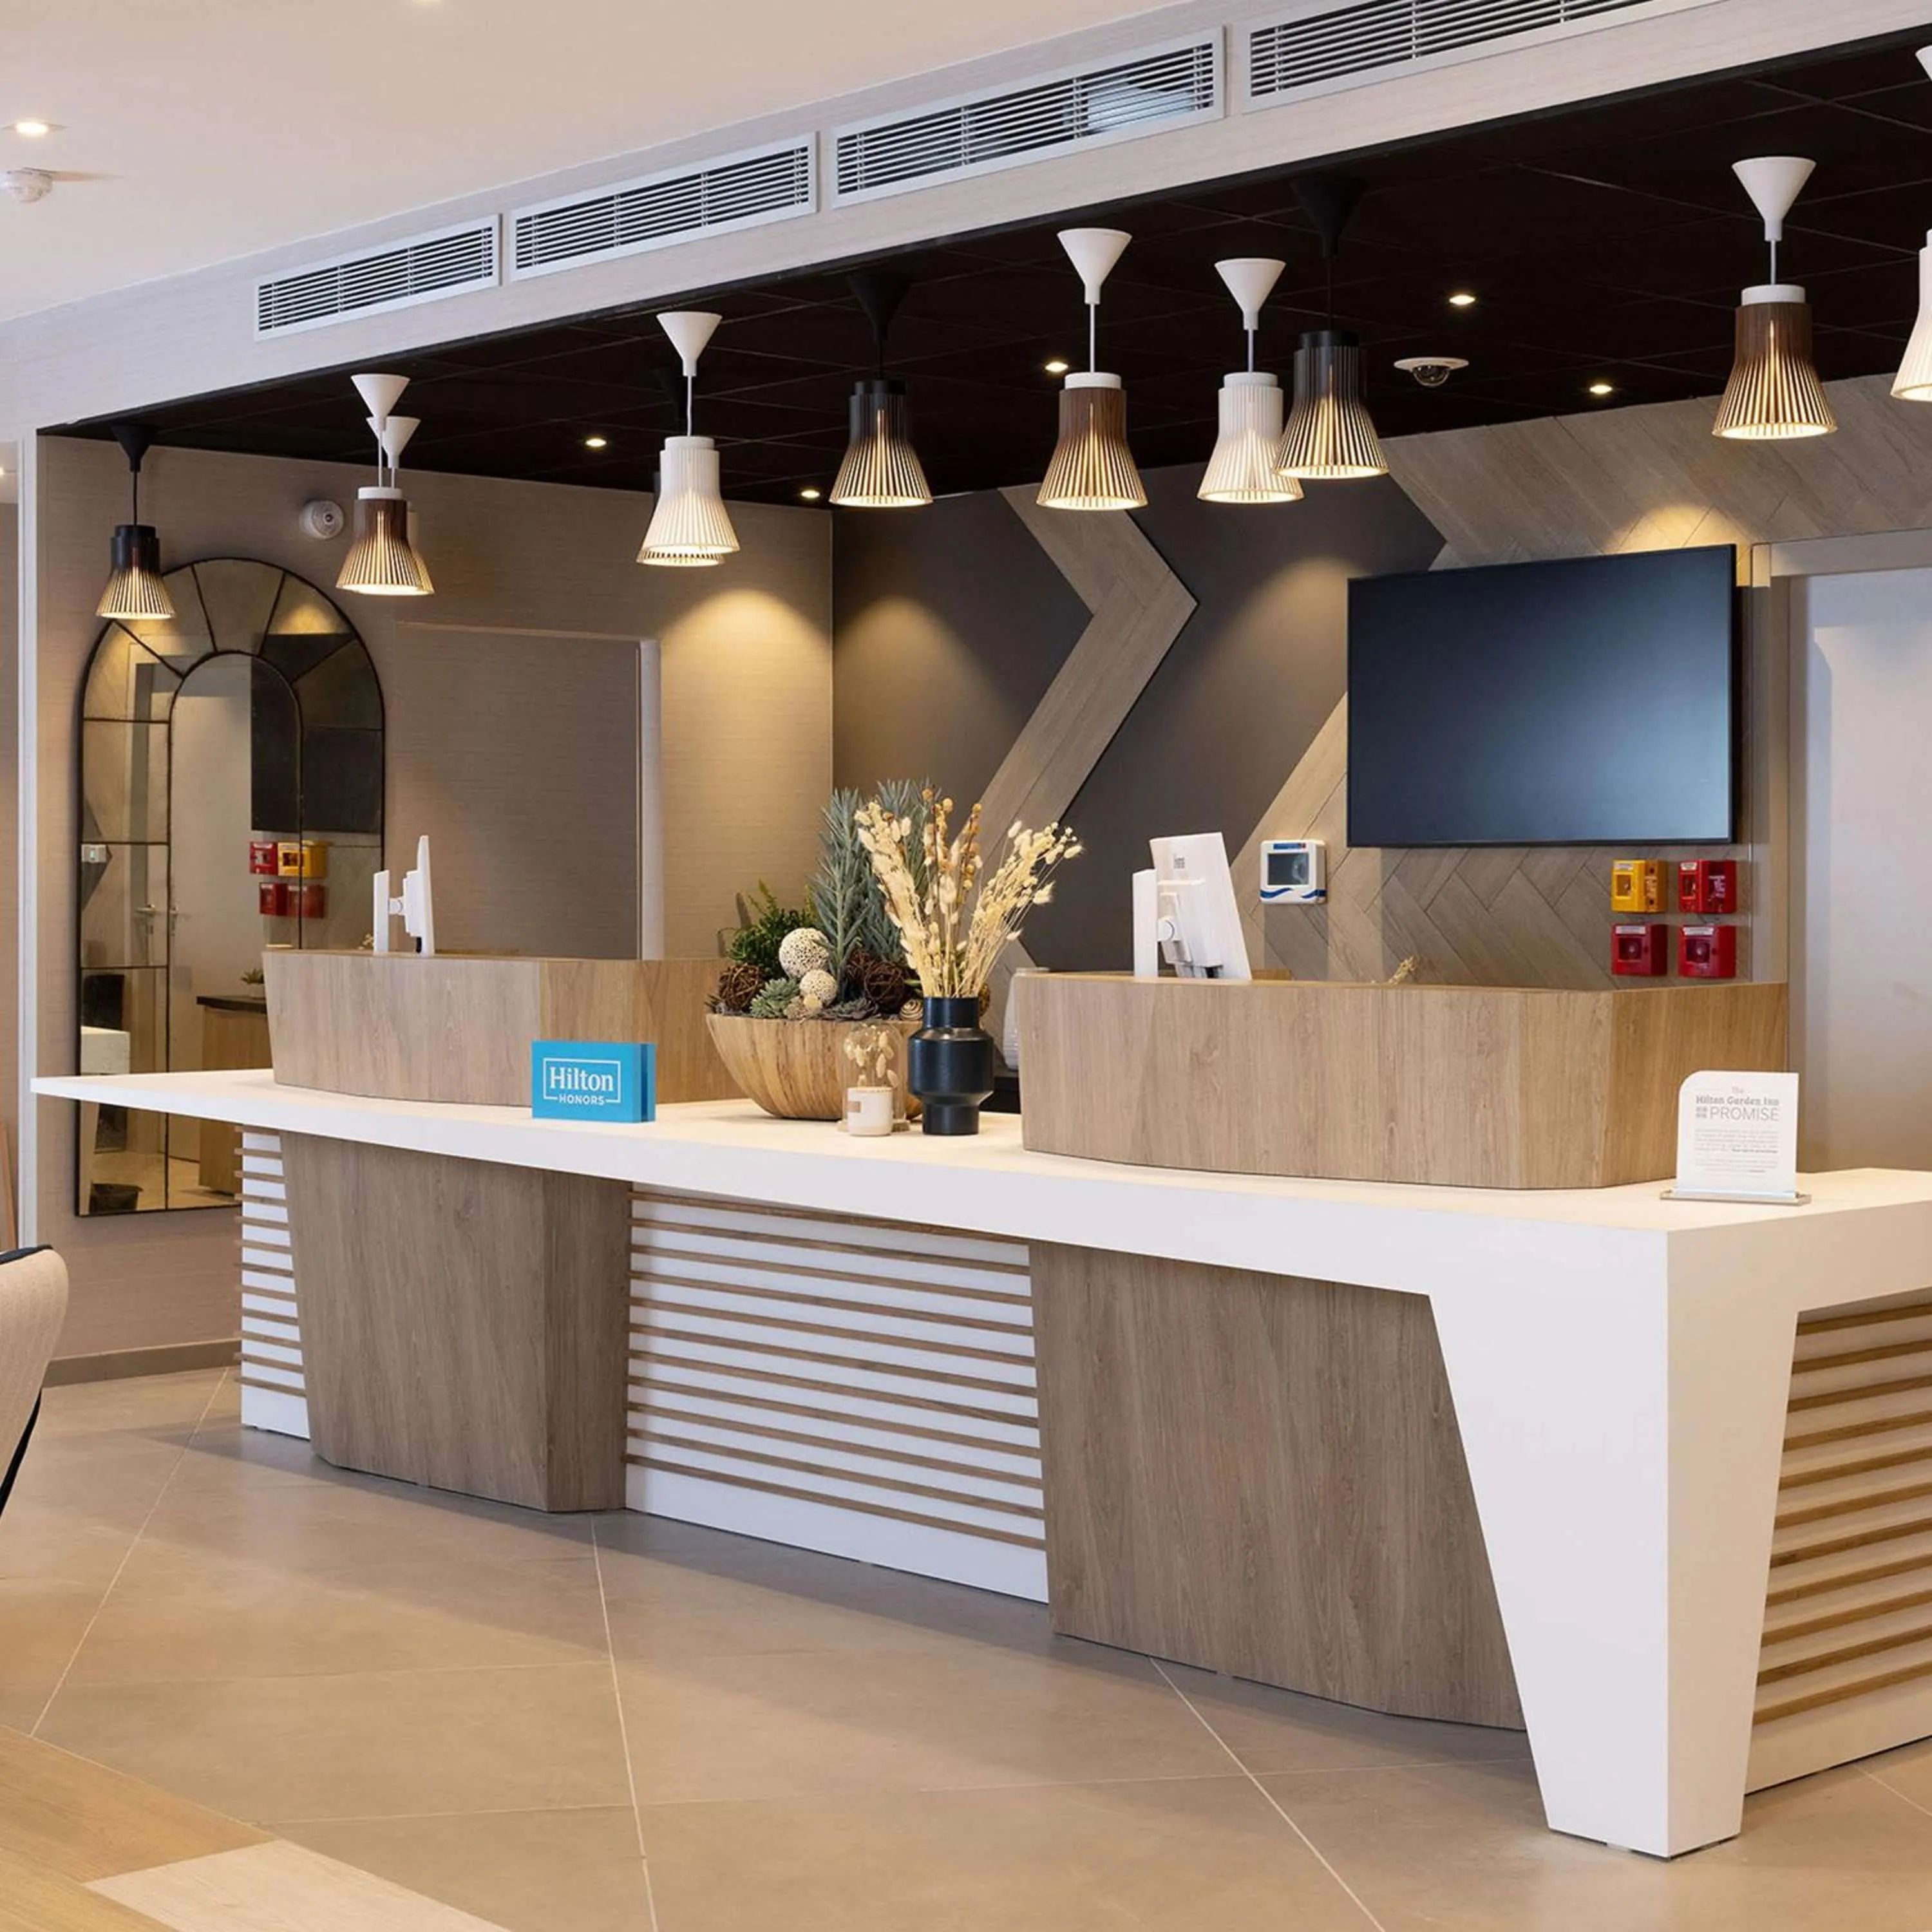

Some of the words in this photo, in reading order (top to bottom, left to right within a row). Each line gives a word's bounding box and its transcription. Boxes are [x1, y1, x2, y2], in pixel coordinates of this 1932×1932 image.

[549, 1066, 614, 1092] Hilton
[559, 1094, 605, 1106] HONORS
[1696, 1095, 1725, 1104] Hilton
[1727, 1096, 1761, 1106] Garden
[1763, 1097, 1779, 1106] Inn
[1710, 1106, 1779, 1121] PROMISE
